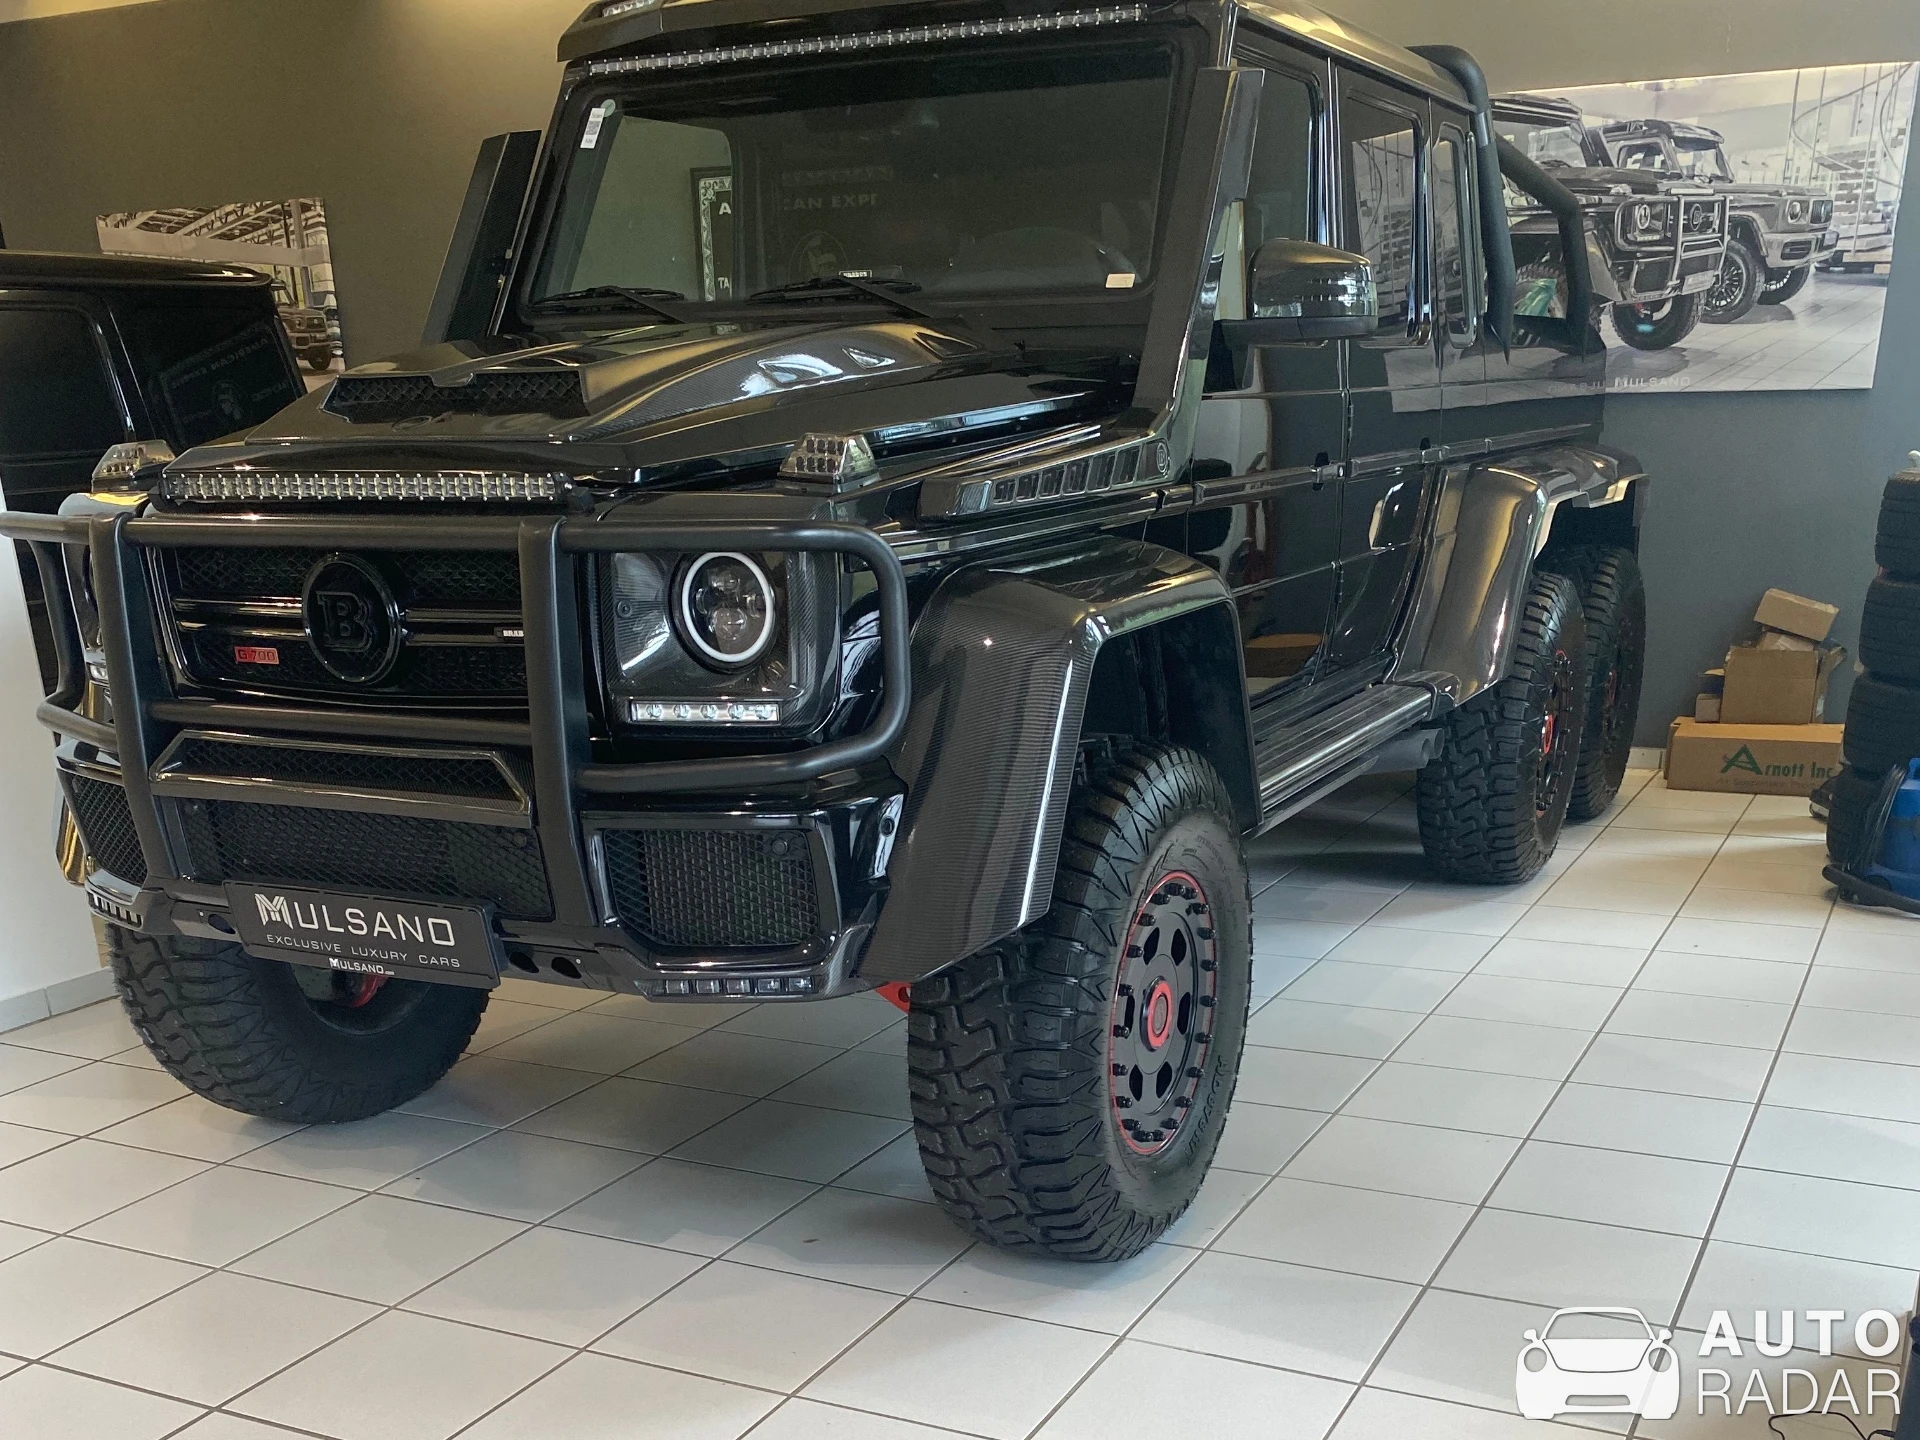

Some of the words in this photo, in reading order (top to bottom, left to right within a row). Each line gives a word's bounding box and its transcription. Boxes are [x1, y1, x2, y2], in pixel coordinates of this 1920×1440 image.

[1720, 744, 1804, 778] Arnott
[254, 893, 456, 946] MULSANO
[266, 934, 342, 953] EXCLUSIVE
[351, 946, 408, 961] LUXURY
[419, 954, 460, 968] CARS
